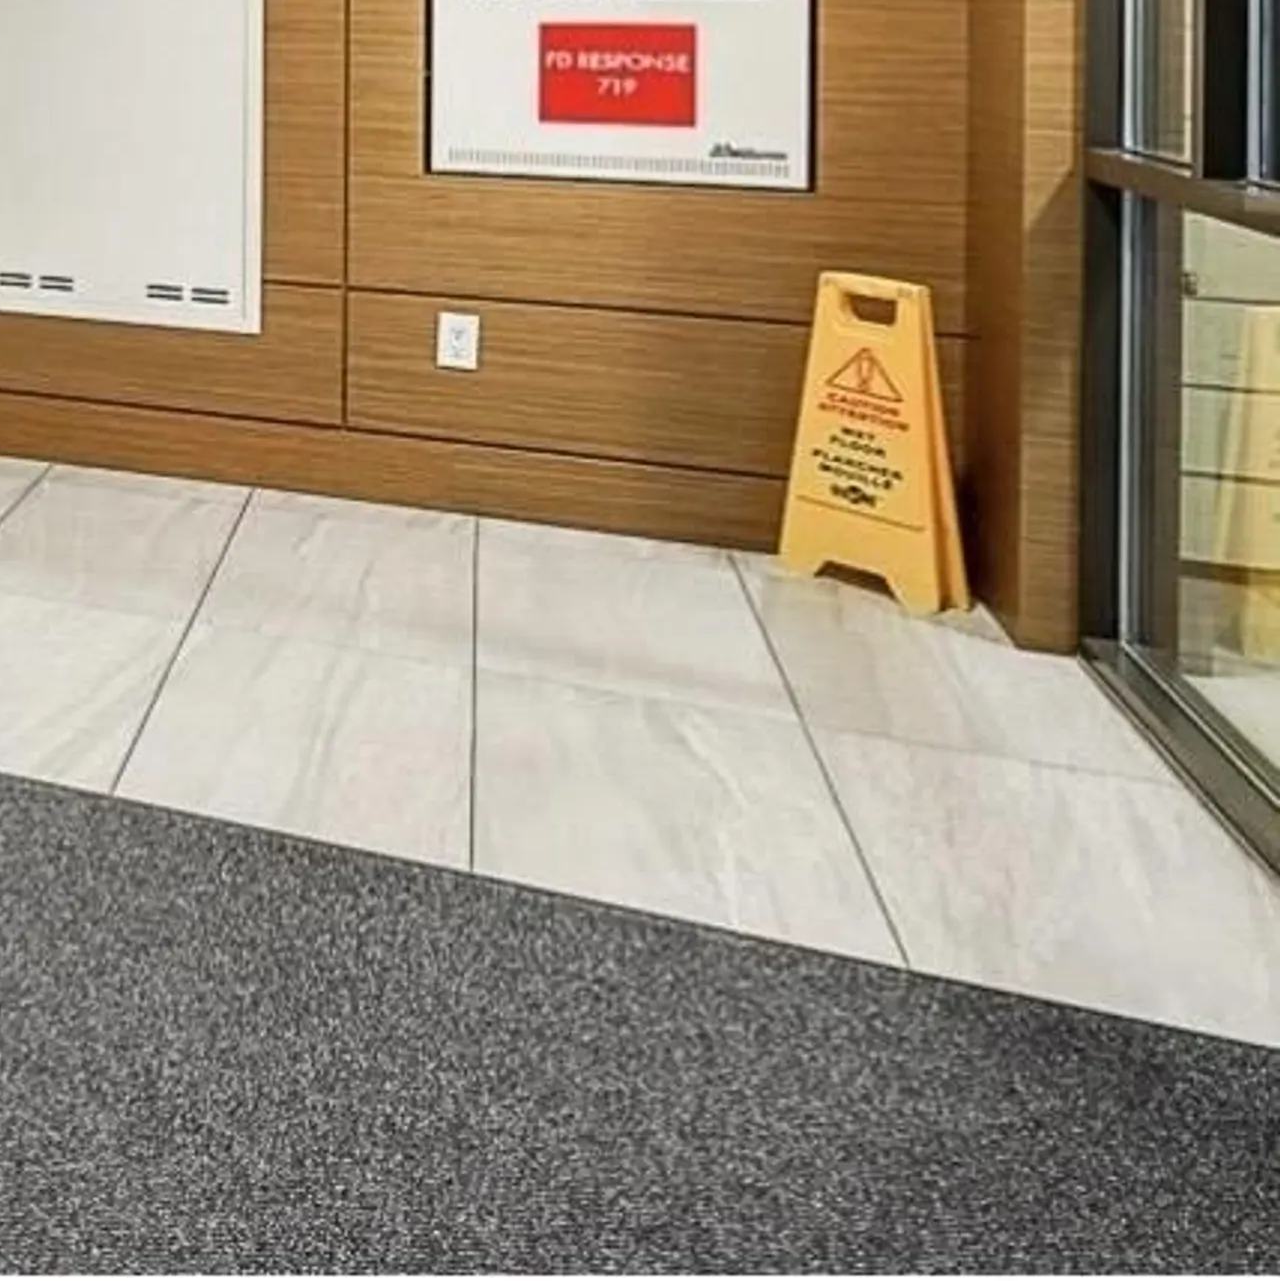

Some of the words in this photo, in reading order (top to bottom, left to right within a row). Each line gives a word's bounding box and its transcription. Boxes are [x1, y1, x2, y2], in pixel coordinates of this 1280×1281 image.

[577, 49, 691, 73] RESPONSE
[596, 76, 639, 97] 719
[826, 392, 901, 419] CAUTION
[828, 433, 887, 459] FLOOR
